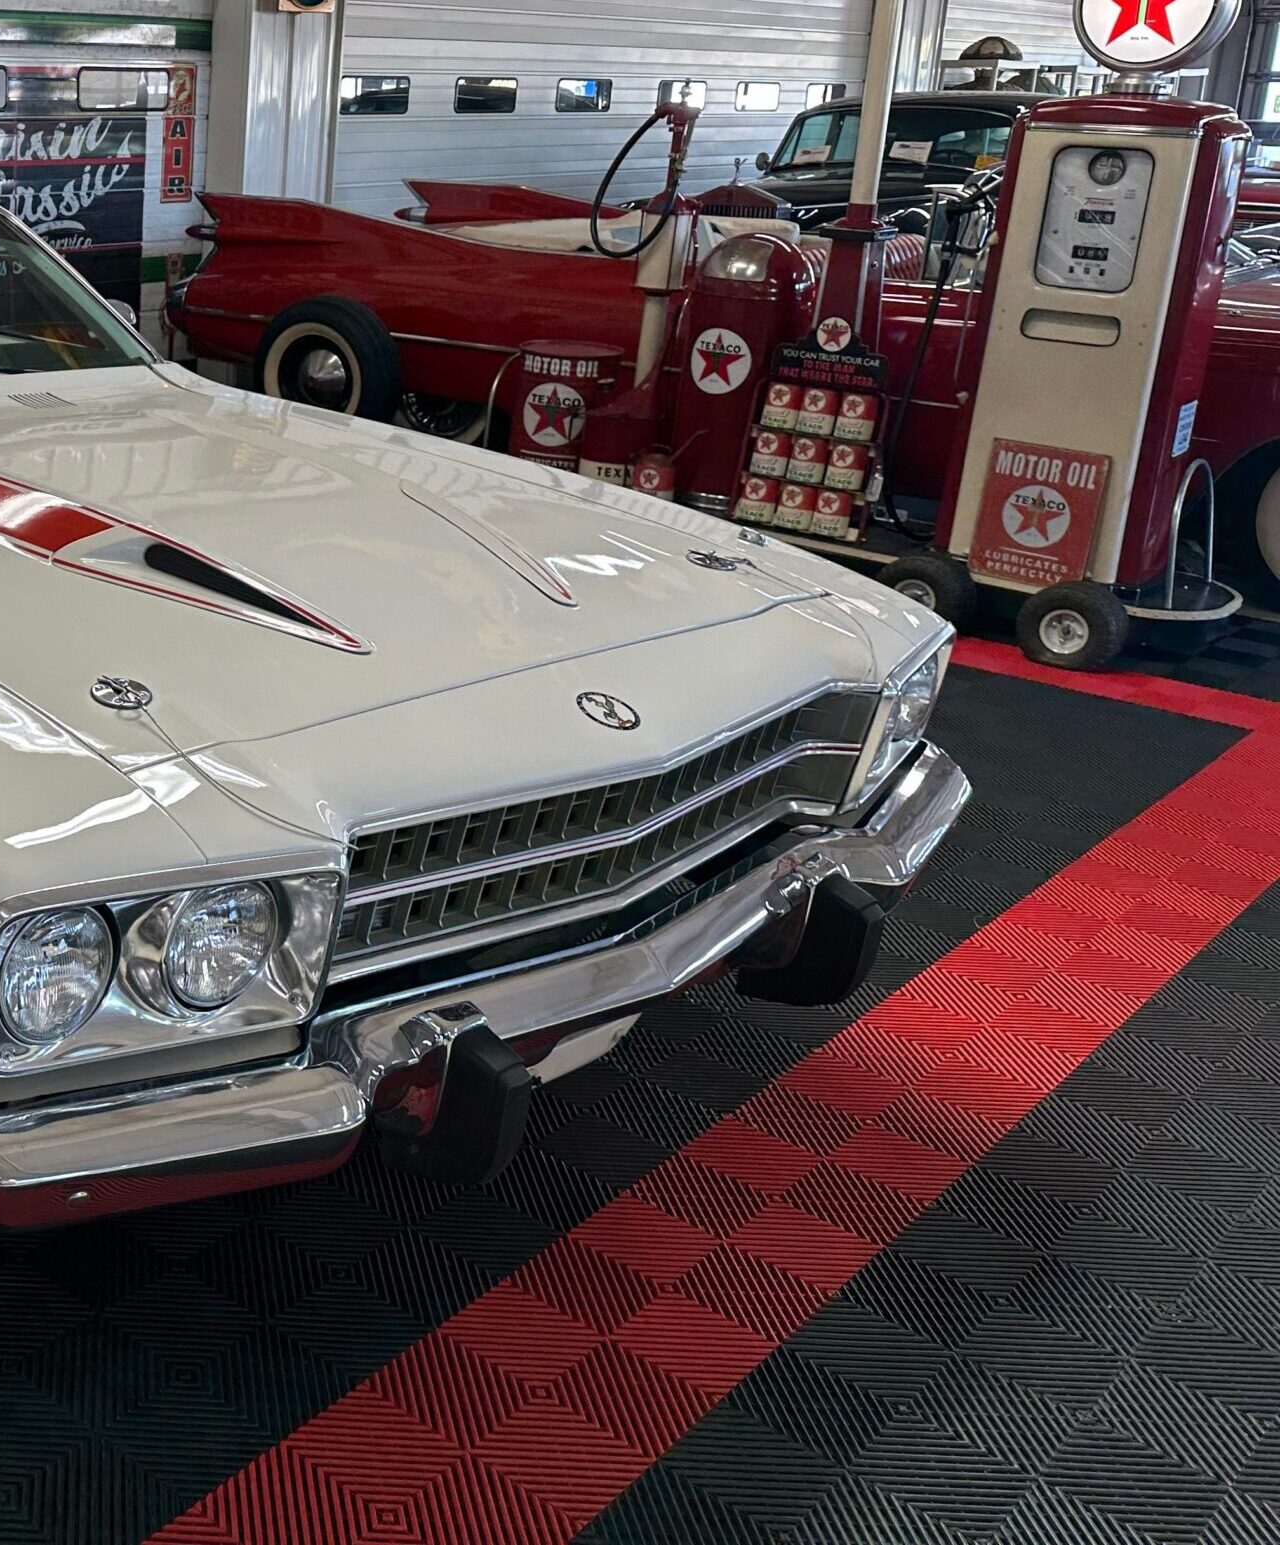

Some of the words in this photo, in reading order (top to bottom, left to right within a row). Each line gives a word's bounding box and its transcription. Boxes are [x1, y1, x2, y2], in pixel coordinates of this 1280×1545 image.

[167, 119, 189, 196] AIR
[699, 340, 742, 354] TEXACO
[782, 348, 799, 358] YOU
[799, 350, 817, 360] CAN
[818, 353, 840, 362] TRUST
[841, 356, 862, 365] YOUR
[863, 358, 880, 368] CAR
[523, 355, 571, 377] MOTOR
[575, 359, 599, 378] OIL
[531, 393, 582, 409] TEXACO
[995, 449, 1064, 484] MOTOR
[1066, 461, 1097, 490] OIL
[1014, 494, 1067, 512] TEXACO
[984, 549, 1069, 574] LUBRICATES
[986, 560, 1064, 583] PERFECTLY
